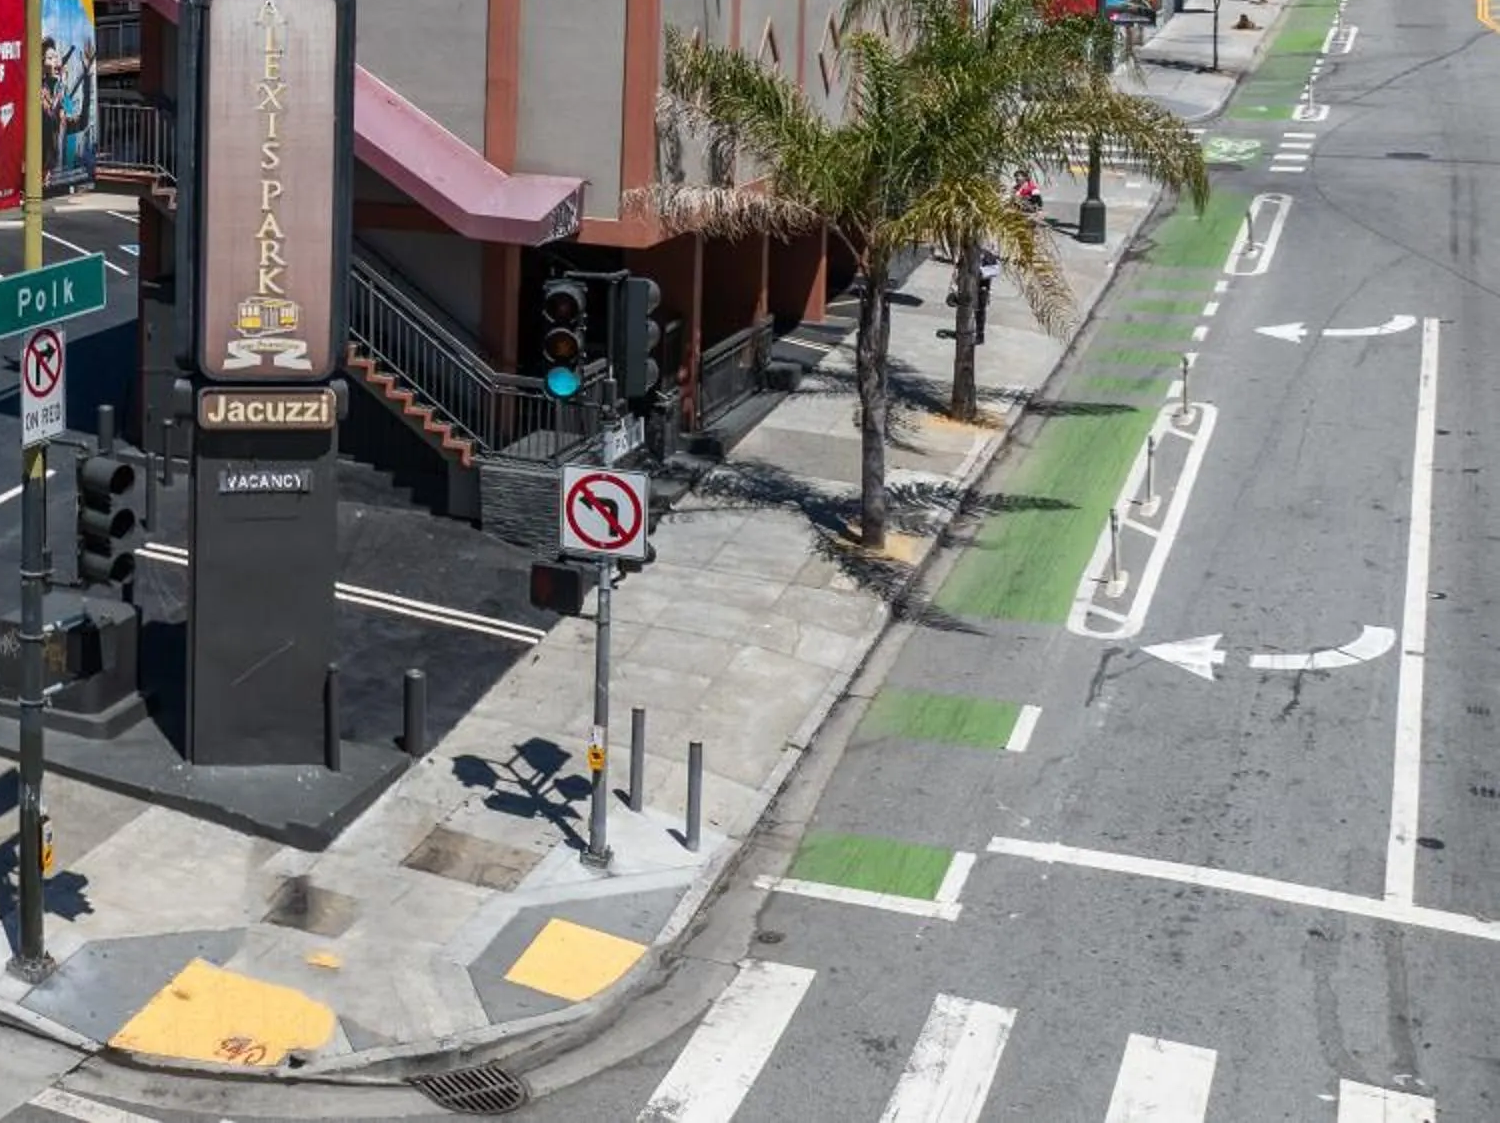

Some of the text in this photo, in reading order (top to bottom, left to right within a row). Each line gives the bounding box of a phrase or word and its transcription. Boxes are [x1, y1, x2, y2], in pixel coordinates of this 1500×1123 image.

[256, 180, 286, 295] PARK
[18, 277, 74, 317] Polk
[25, 402, 61, 431] ON RED
[207, 395, 329, 422] Jacuzzi
[228, 474, 303, 489] VACANCY
